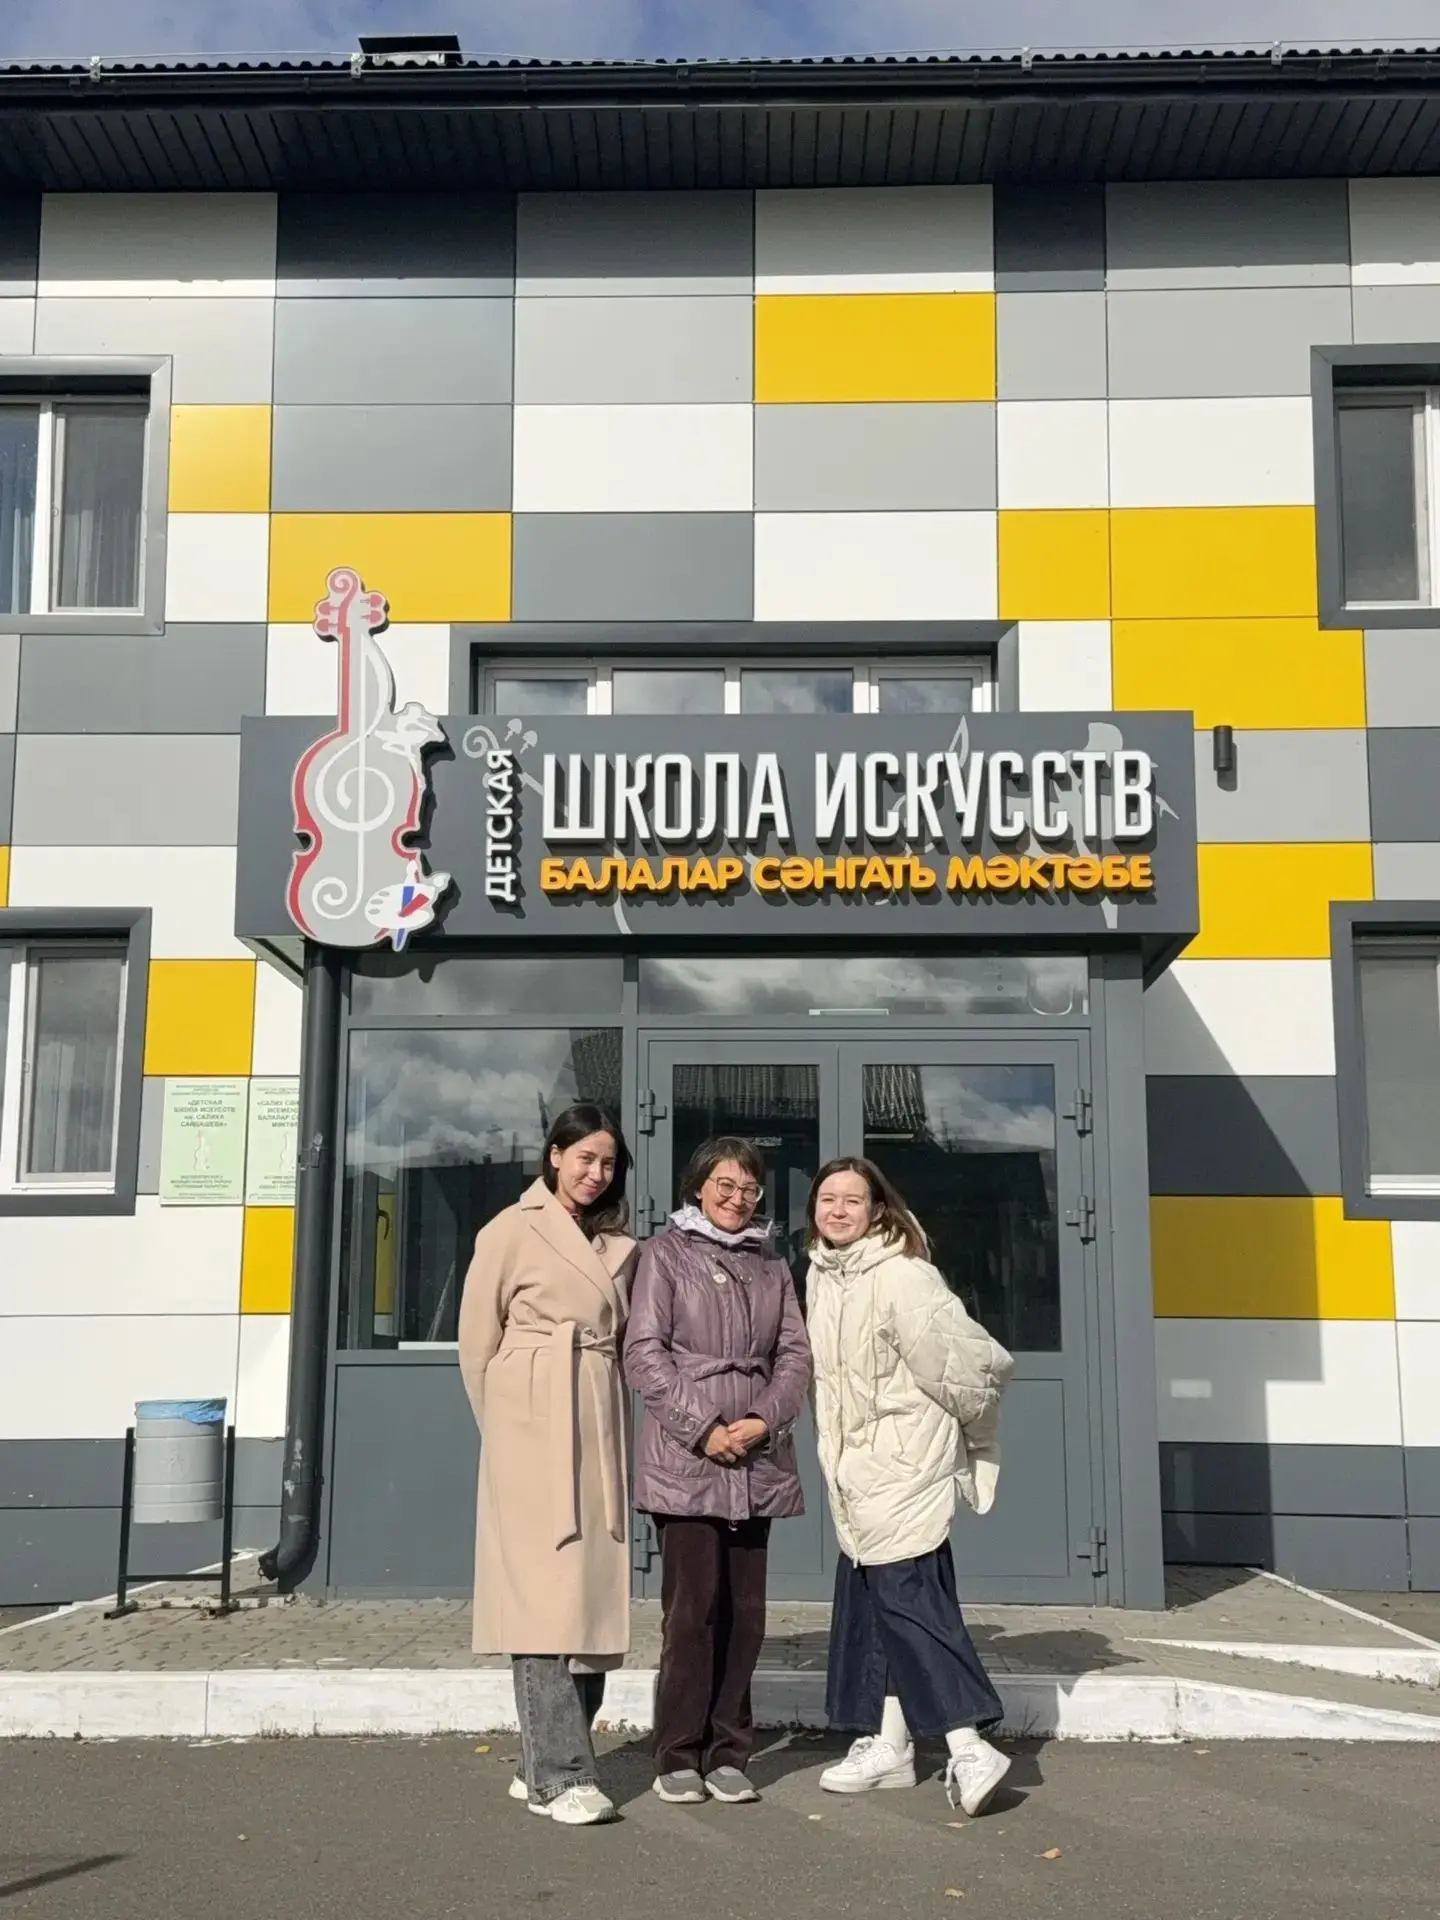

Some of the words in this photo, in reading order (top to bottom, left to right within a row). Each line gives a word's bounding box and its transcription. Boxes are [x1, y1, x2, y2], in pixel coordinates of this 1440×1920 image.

[484, 748, 517, 903] ДЕТСКАЯ
[542, 752, 791, 843] ШКОЛА
[814, 749, 1154, 842] ИСКУССТВ
[540, 856, 744, 894] БАЛАЛАР
[753, 855, 937, 893] СӘНГАТЬ
[945, 855, 1154, 892] МӘКТӘБЕ
